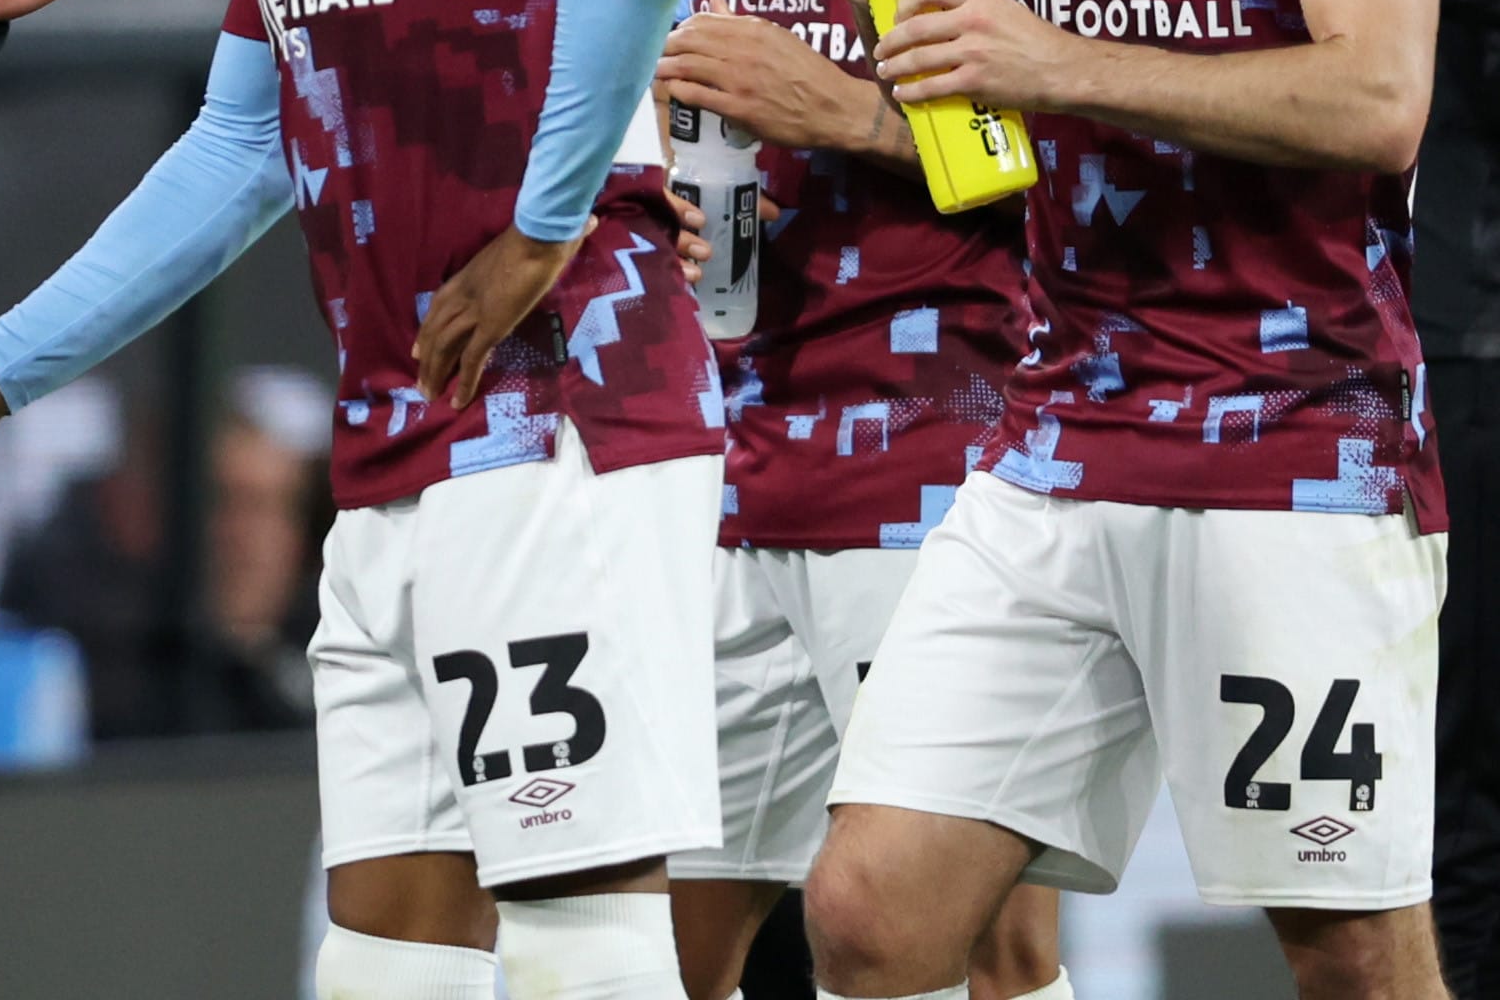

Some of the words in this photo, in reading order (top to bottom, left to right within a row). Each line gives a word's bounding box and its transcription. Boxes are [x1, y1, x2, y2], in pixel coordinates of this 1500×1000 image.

[433, 631, 606, 787] 23
[1220, 674, 1383, 811] 24
[520, 809, 573, 829] umbro
[1298, 848, 1347, 863] umbro
